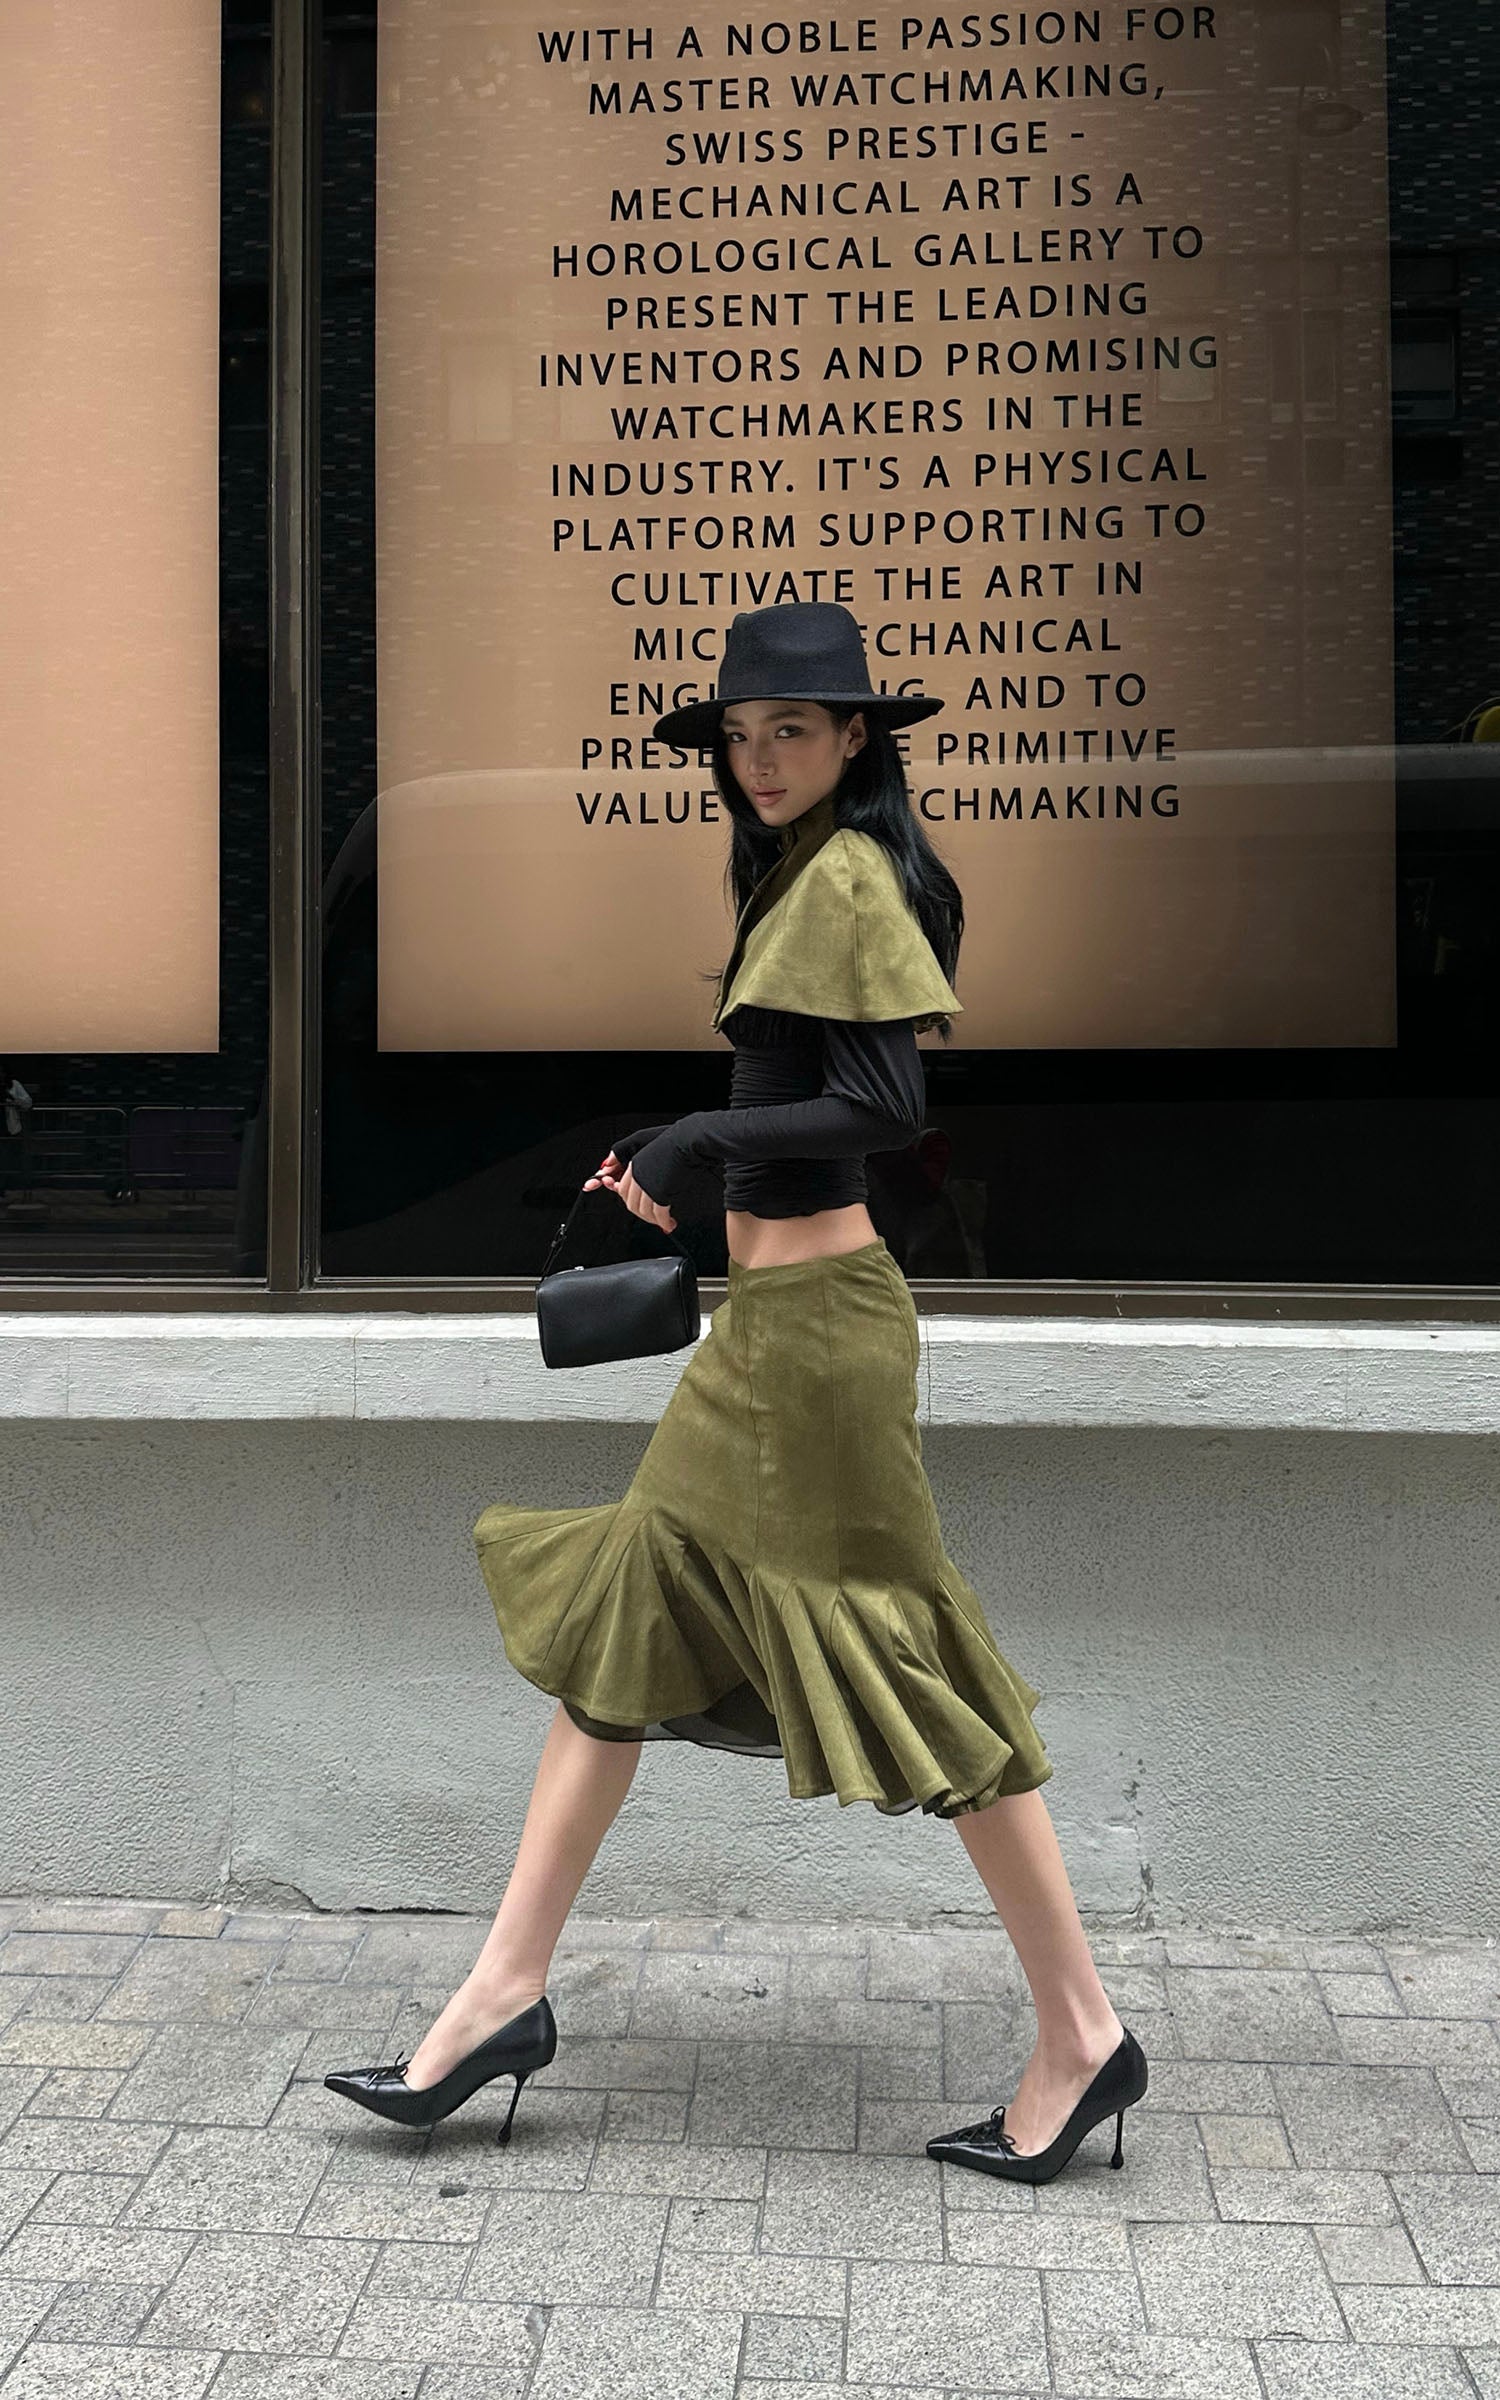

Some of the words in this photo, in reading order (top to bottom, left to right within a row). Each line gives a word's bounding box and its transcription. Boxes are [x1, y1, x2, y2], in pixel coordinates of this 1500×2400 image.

[538, 28, 651, 62] WITH
[677, 27, 703, 58] A
[728, 20, 876, 56] NOBLE
[902, 11, 1099, 50] PASSION
[1128, 7, 1216, 40] FOR
[590, 77, 770, 114] MASTER
[791, 63, 1163, 106] WATCHMAKING,
[666, 130, 802, 165] SWISS
[829, 122, 1047, 160] PRESTIGE
[611, 181, 919, 221] MECHANICAL
[943, 177, 1030, 211] ART
[1055, 174, 1091, 206] IS
[1116, 173, 1143, 205] A
[554, 237, 891, 277] HOROLOGICAL
[915, 228, 1124, 266] GALLERY
[1143, 226, 1202, 259] TO
[608, 293, 808, 330] PRESENT
[827, 290, 913, 324] THE
[940, 283, 1146, 321] LEADING
[541, 349, 799, 386] INVENTORS
[824, 345, 921, 379] AND
[948, 336, 1216, 376] PROMISING
[611, 399, 962, 440] WATCHMAKERS
[989, 397, 1031, 430] IN
[1054, 394, 1142, 428] THE
[553, 460, 793, 496] INDUSTRY.
[819, 457, 899, 491] IT'S
[923, 456, 950, 488] A
[976, 448, 1206, 486] PHYSICAL
[554, 515, 794, 551] PLATFORM
[820, 506, 1122, 546] SUPPORTING
[1145, 504, 1204, 537] TO
[612, 570, 853, 605] CULTIVATE
[875, 567, 961, 600] THE
[985, 564, 1073, 598] ART
[1098, 562, 1141, 595] IN
[965, 676, 1064, 709] AND
[1086, 673, 1145, 707] TO
[582, 738, 716, 769] PRESE
[938, 729, 1176, 765] PRIMITIVE
[908, 785, 1179, 821] CHMAKING
